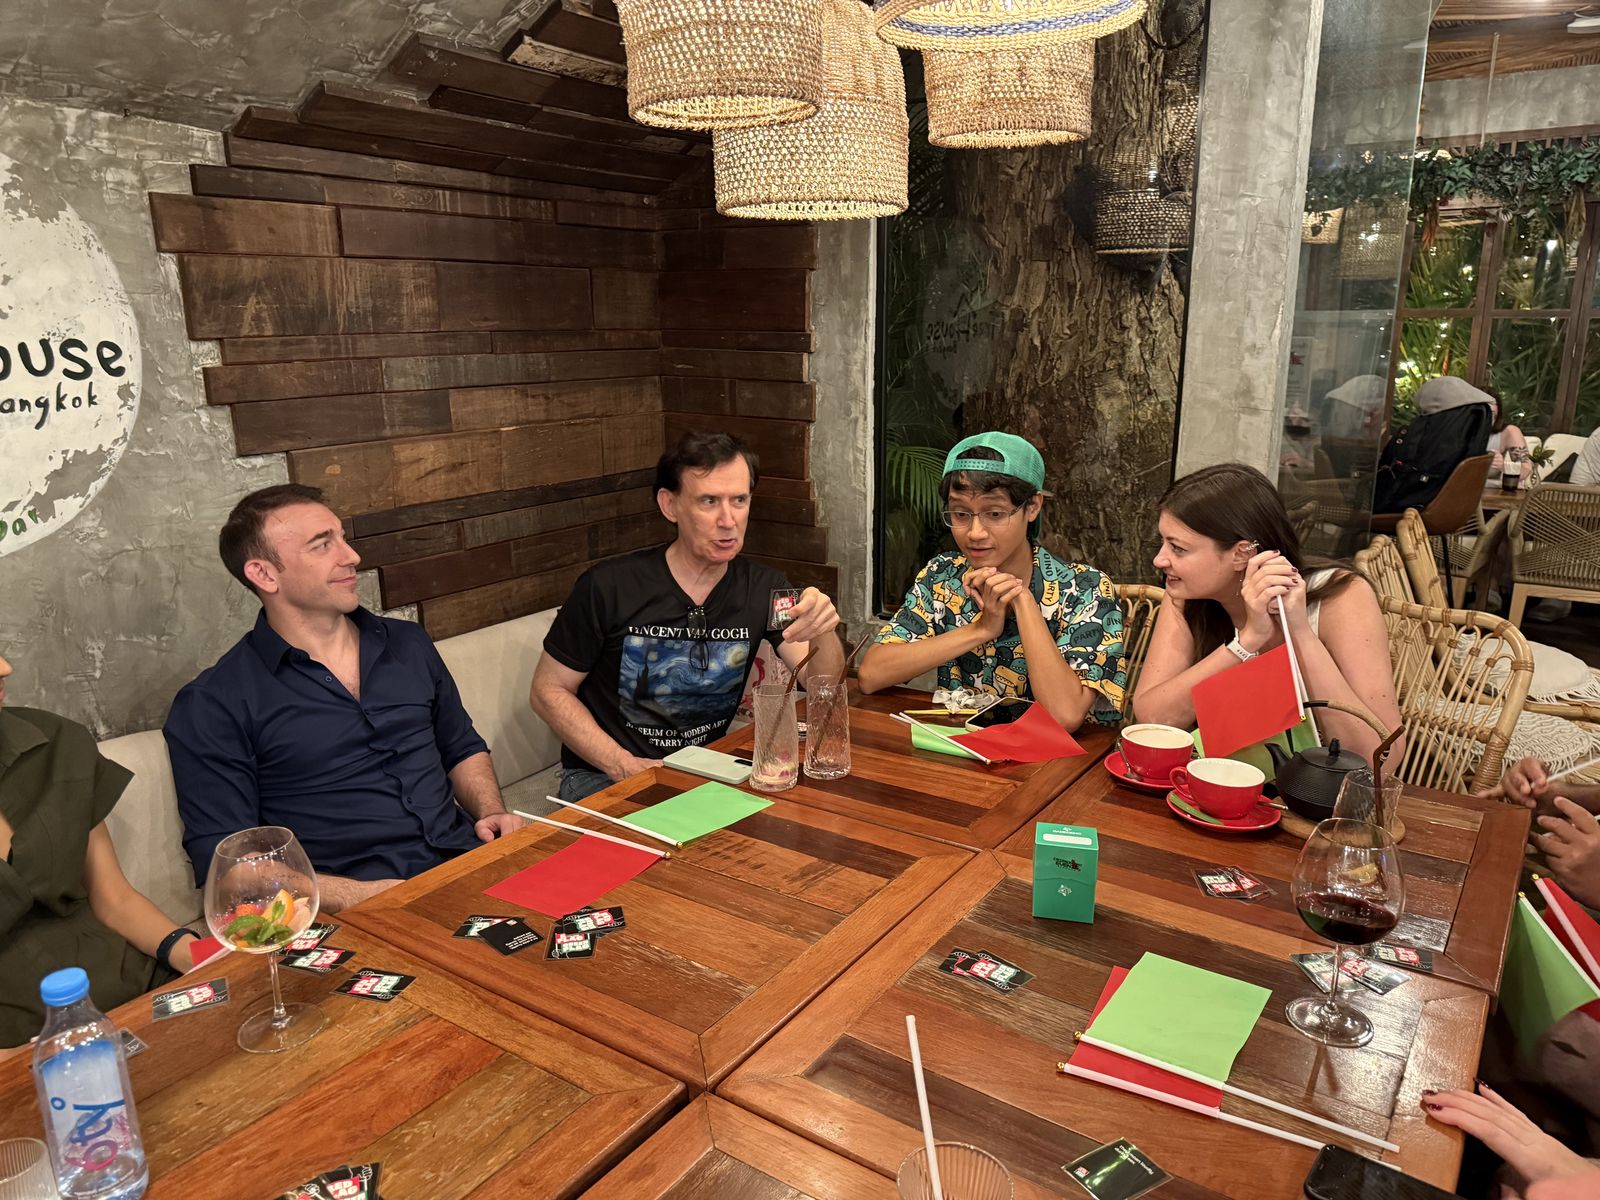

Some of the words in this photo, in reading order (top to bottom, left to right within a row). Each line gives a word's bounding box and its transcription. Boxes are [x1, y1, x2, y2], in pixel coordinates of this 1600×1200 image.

[711, 627, 749, 640] GOGH
[1073, 628, 1102, 644] PARTY
[625, 721, 663, 737] MSEUM
[680, 723, 711, 739] MODERN
[711, 718, 728, 730] ART
[649, 738, 683, 747] STARRY
[685, 734, 707, 746] NIGHT
